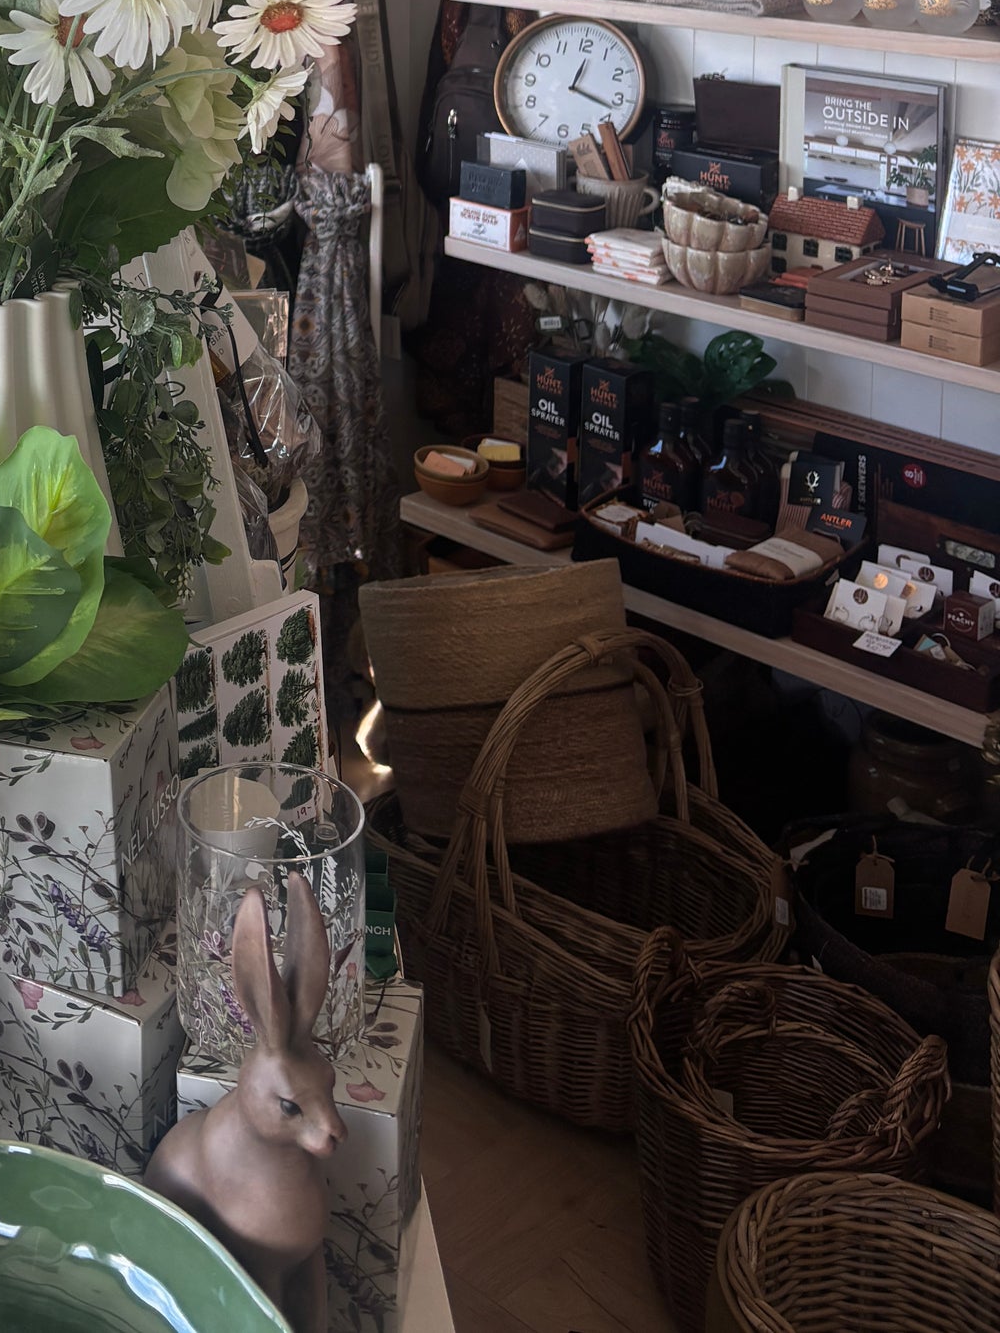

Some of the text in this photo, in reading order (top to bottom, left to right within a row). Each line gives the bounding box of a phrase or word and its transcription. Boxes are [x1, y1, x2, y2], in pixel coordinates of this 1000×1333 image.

[556, 40, 567, 55] 11
[579, 38, 594, 54] 12
[536, 53, 551, 68] 10
[603, 48, 609, 61] 1
[524, 73, 537, 87] 9
[612, 68, 624, 82] 2
[525, 95, 537, 108] 8
[611, 92, 624, 107] 3
[825, 95, 872, 111] BRING THE
[538, 114, 549, 127] 7
[822, 105, 909, 131] OUTSIDE IN
[557, 124, 569, 138] 6
[700, 171, 729, 185] HUNT
[536, 373, 562, 388] HUNT
[590, 387, 617, 402] HUNT
[538, 398, 559, 415] OIL
[531, 407, 565, 427] SPRAYER
[592, 412, 613, 429] OIL
[584, 421, 620, 441] SPRAYER
[858, 454, 867, 503] SKEWERS
[820, 513, 852, 528] ANTLER
[121, 773, 180, 876] NEL LUSSO
[365, 925, 391, 936] NCH
